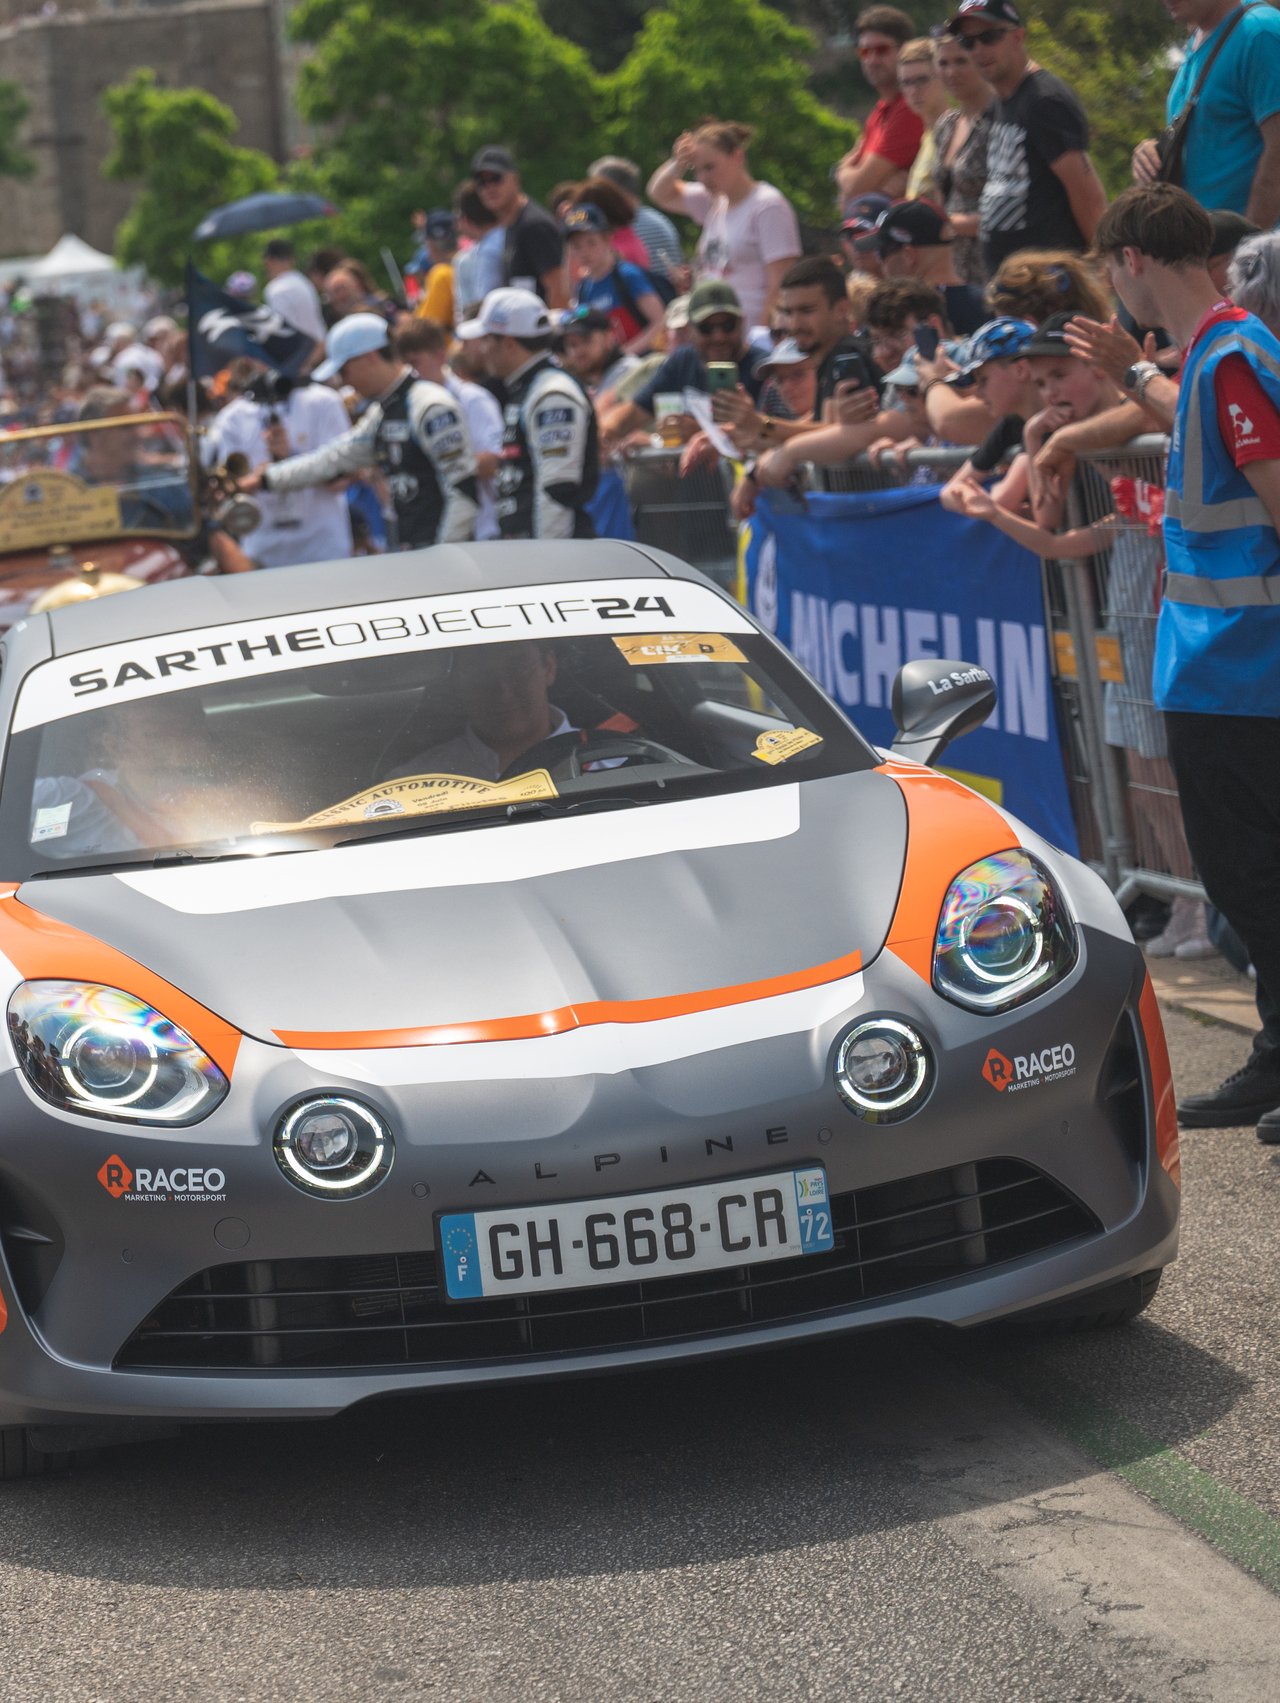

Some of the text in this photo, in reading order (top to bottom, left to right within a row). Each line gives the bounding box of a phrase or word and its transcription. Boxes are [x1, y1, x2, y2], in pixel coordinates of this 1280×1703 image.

[69, 596, 676, 698] SARTHEOBJECTIF24
[927, 675, 952, 696] La
[372, 779, 491, 800] AUTOMOTIVE
[1014, 1043, 1076, 1080] RACEO
[1007, 1067, 1077, 1093] MARKETING MOTORSPORT
[468, 1125, 789, 1188] ALPINE
[135, 1168, 226, 1191] RACEO
[124, 1193, 227, 1202] MARKETING MOTORSPORT
[487, 1187, 789, 1281] GH-668-CR
[800, 1211, 831, 1243] 72
[457, 1264, 468, 1281] F
